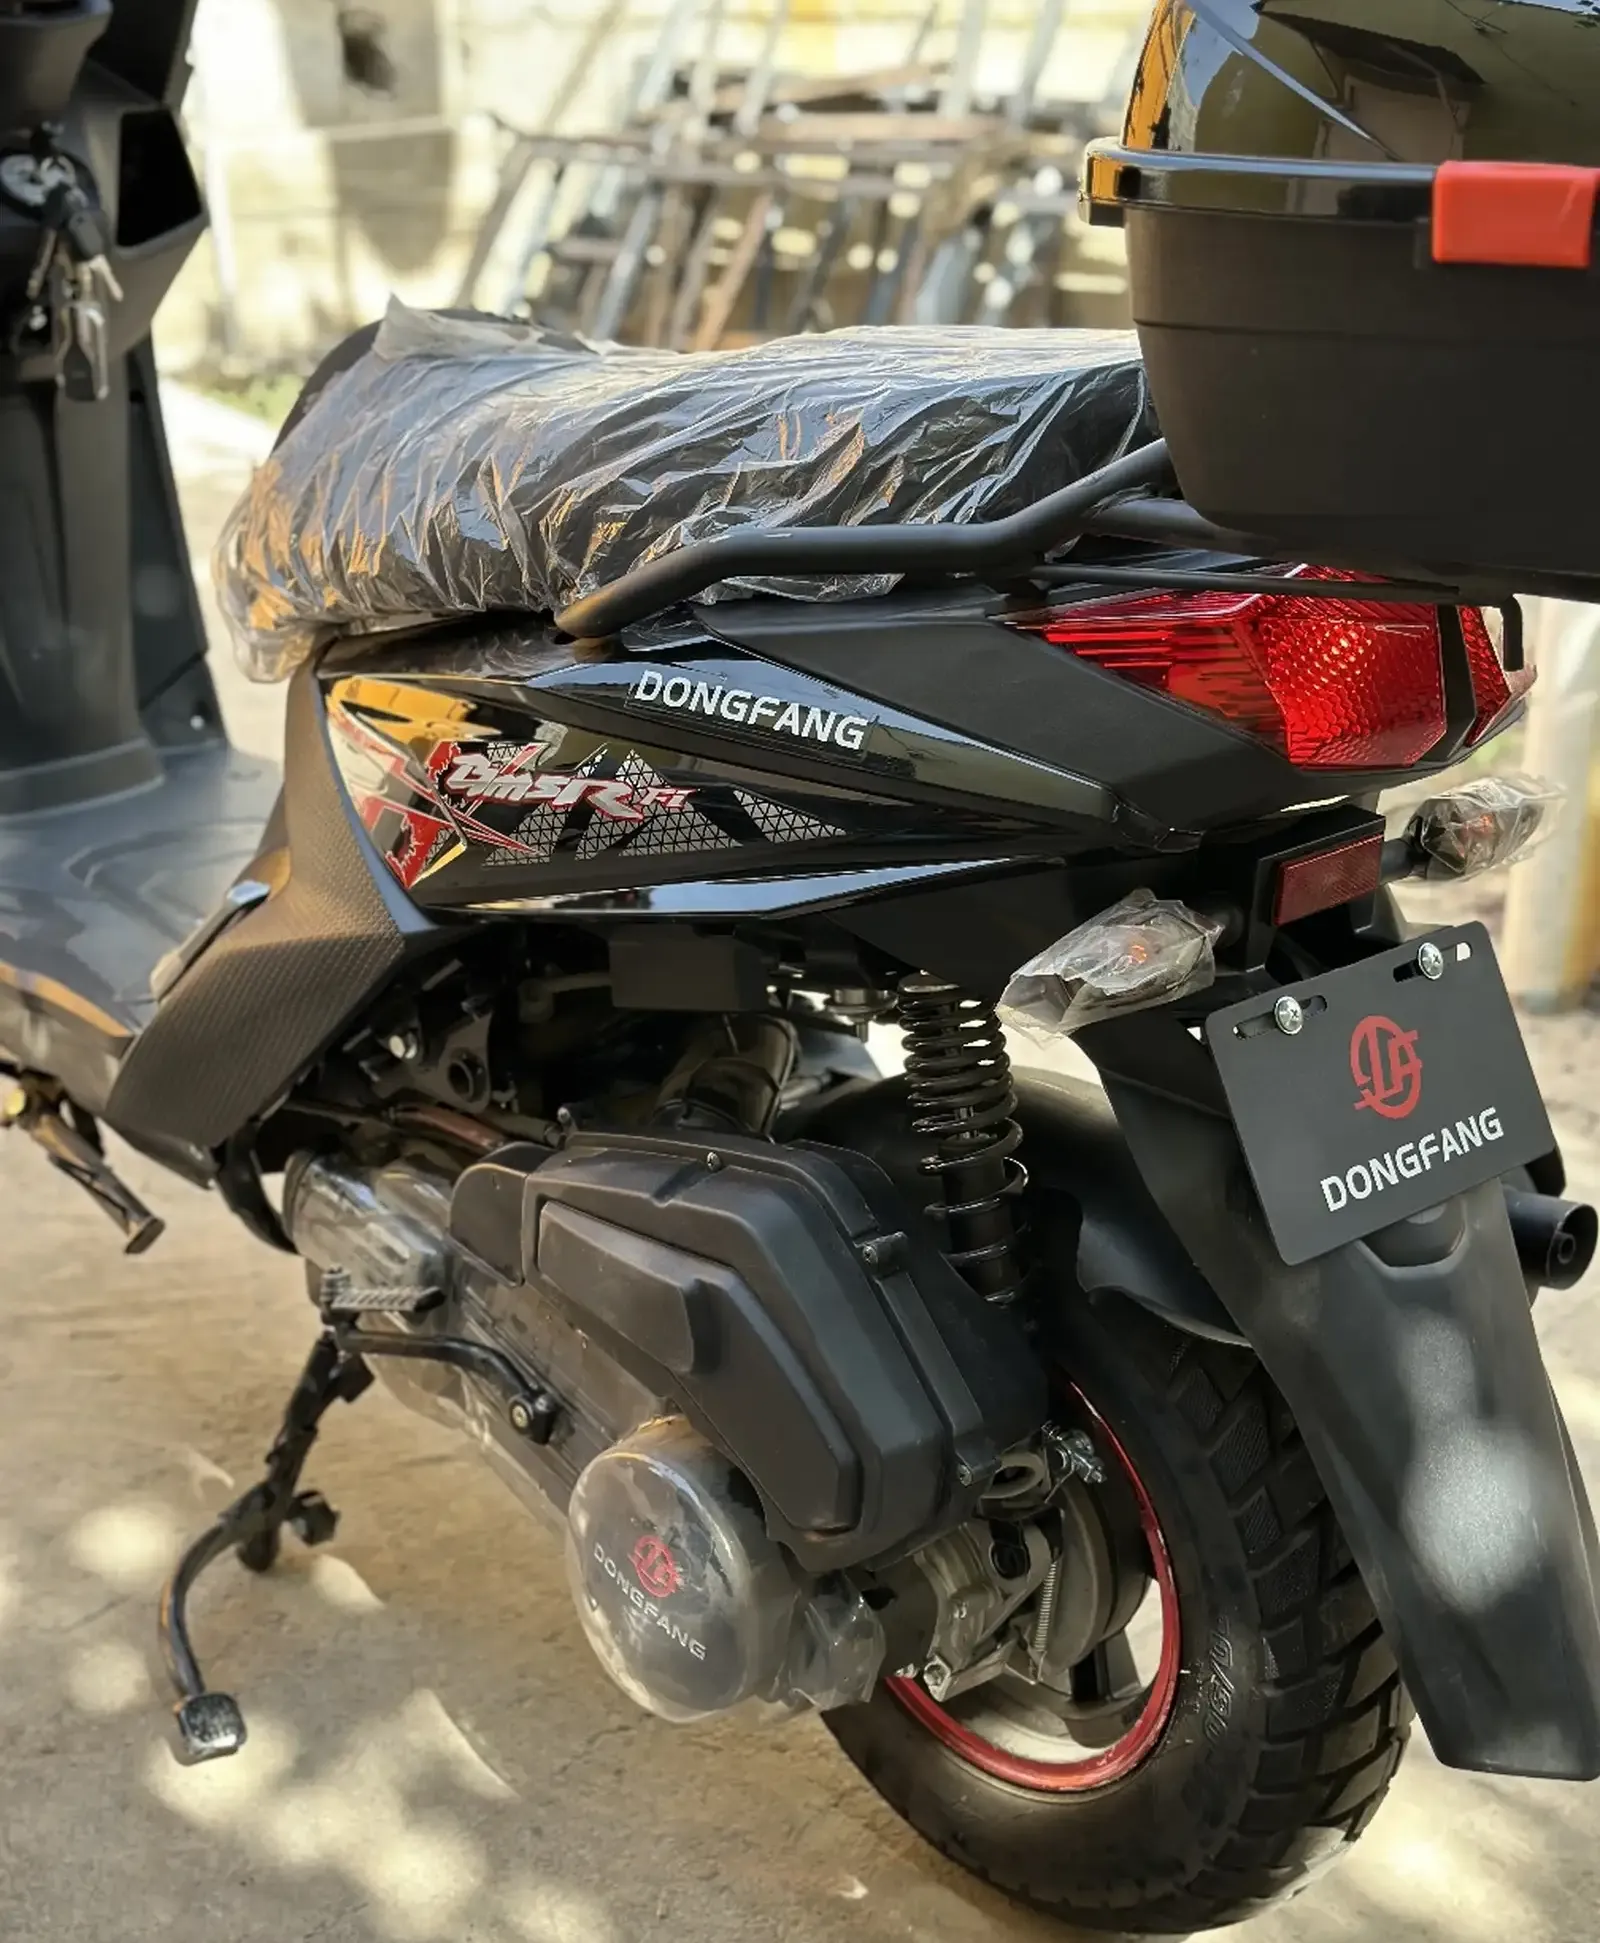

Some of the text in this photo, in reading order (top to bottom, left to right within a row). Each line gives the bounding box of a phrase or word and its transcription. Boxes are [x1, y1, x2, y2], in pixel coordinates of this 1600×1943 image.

[634, 669, 867, 750] DONGFANG
[1320, 1106, 1504, 1212] DONGFANG
[593, 1542, 707, 1660] DONGFANG
